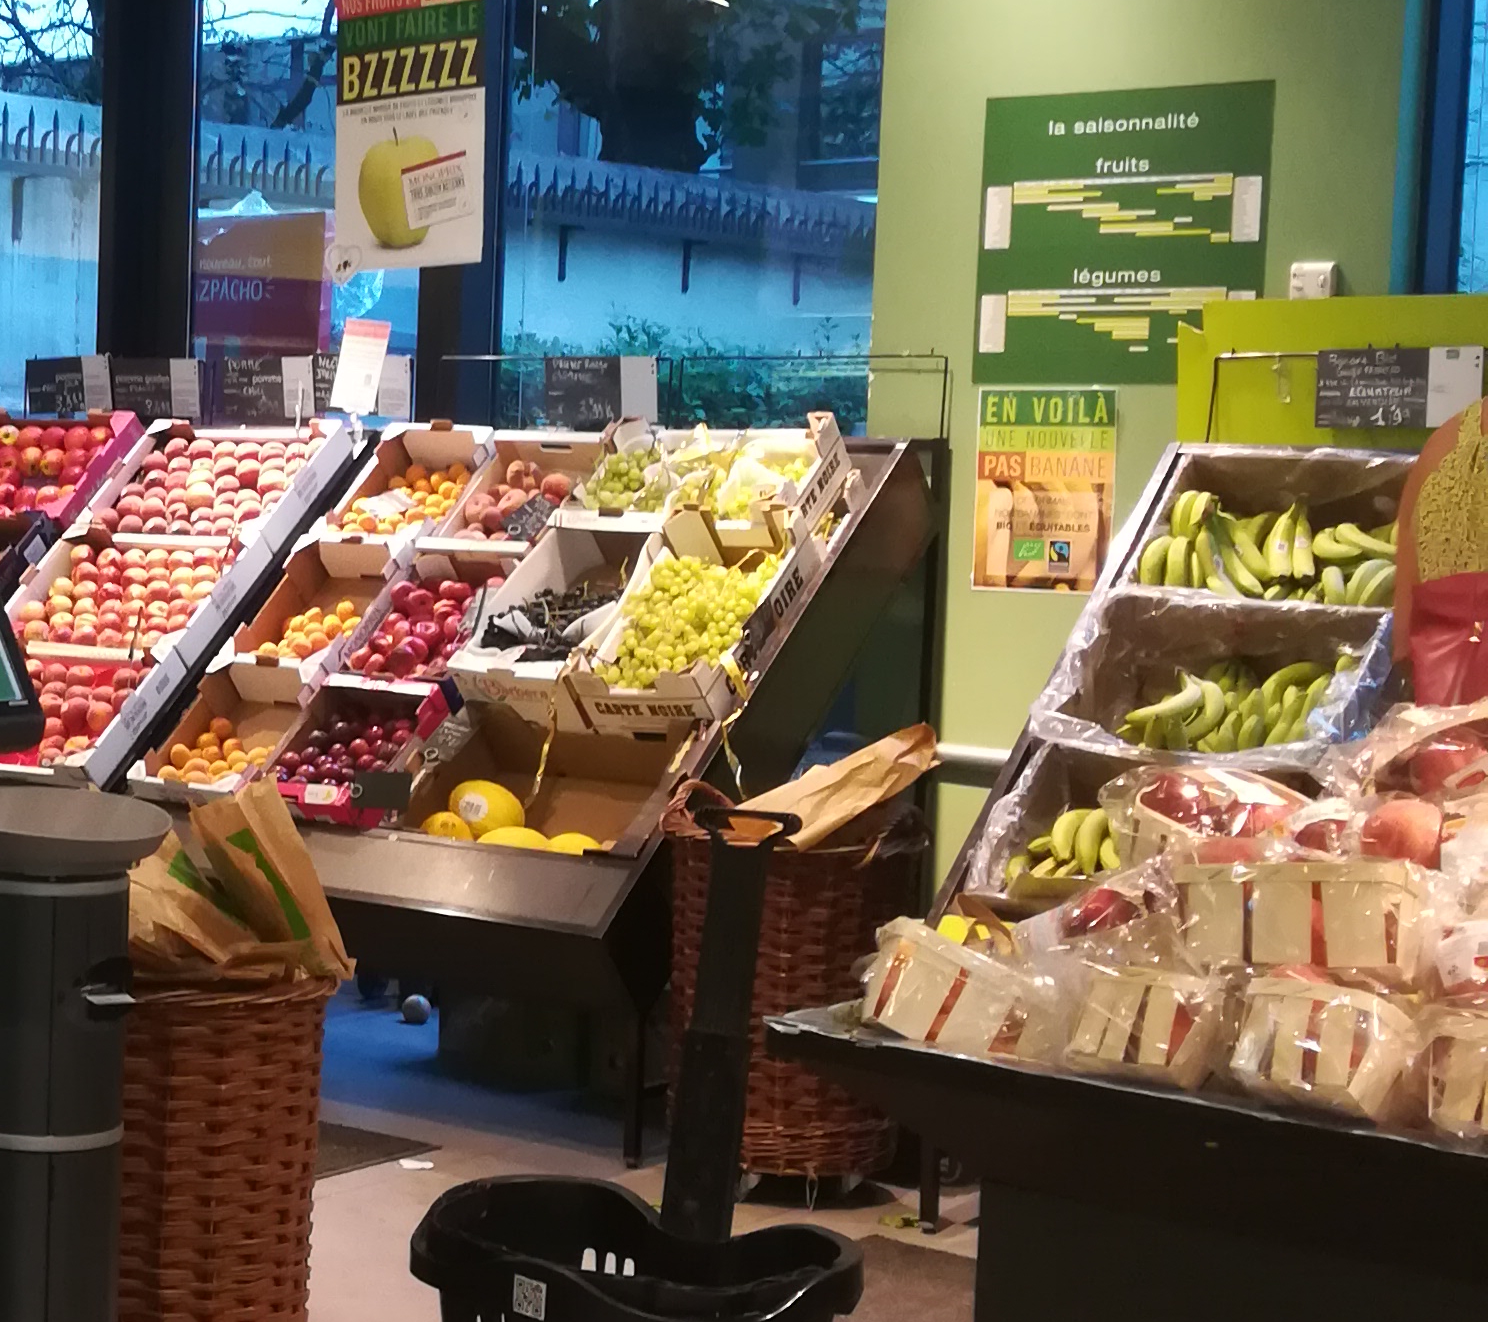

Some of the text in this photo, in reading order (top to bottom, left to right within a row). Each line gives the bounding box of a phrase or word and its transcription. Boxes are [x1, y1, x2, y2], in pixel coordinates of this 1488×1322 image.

[344, 4, 478, 48] VONT FAIRE LE
[342, 38, 478, 102] BZZZZZZ
[1048, 111, 1200, 136] la saisonnalité
[1095, 157, 1150, 174] fruits
[1073, 268, 1161, 287] légumes
[986, 392, 1109, 424] EN VOILÀ
[986, 430, 1109, 450] UNE NOUVELLE
[817, 451, 841, 492] NOIRE
[984, 455, 1107, 478] PAS BANANE
[773, 565, 805, 619] OIRE
[594, 702, 696, 717] CARTE NOIRE
